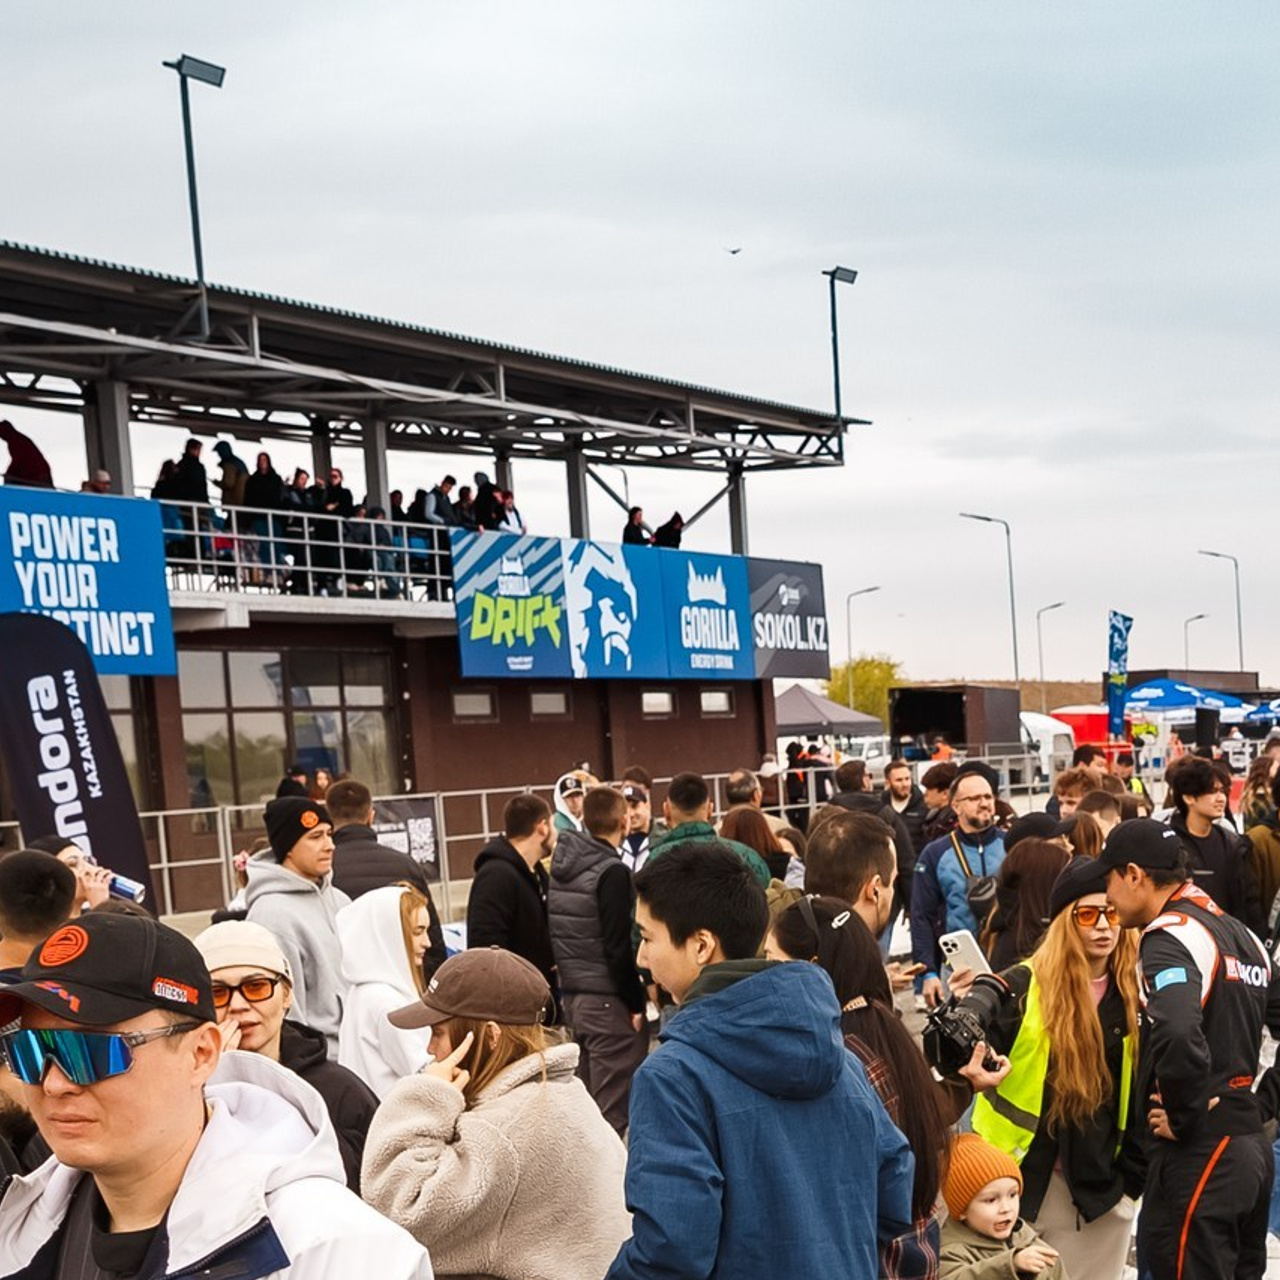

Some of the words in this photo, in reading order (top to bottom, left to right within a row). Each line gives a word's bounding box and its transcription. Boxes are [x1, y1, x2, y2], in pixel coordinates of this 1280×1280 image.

[9, 512, 120, 563] POWER
[14, 560, 100, 609] YOUR
[681, 605, 740, 650] GORILLA
[754, 612, 828, 651] SOKOL.KZ
[62, 669, 104, 799] KAZAKHSTAN
